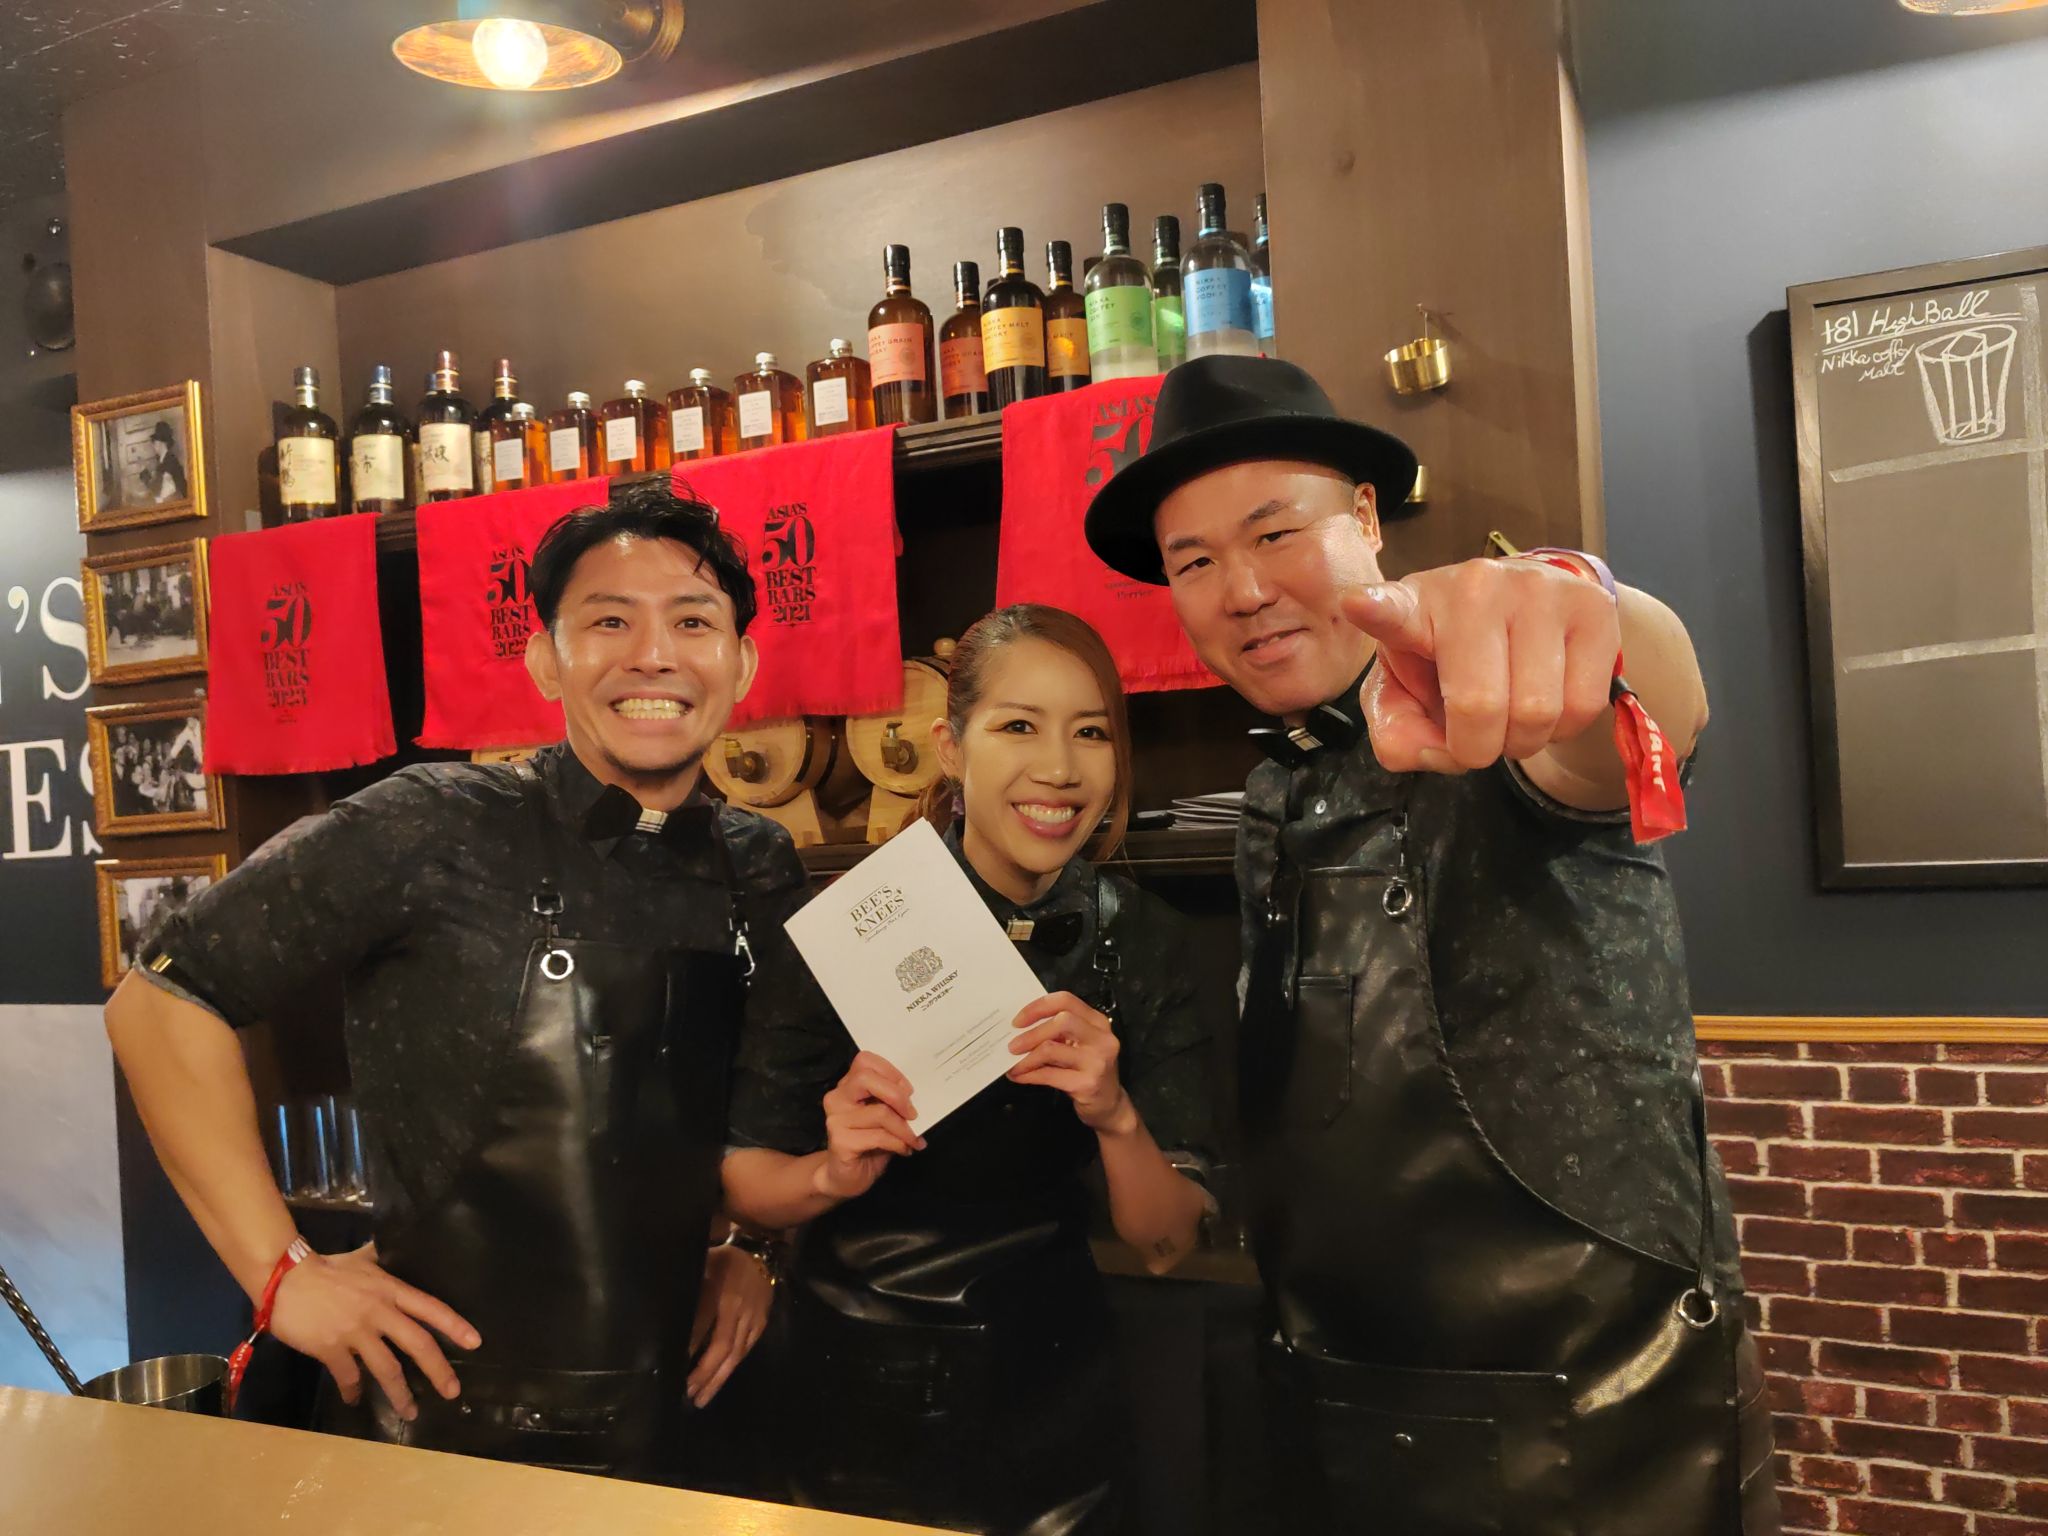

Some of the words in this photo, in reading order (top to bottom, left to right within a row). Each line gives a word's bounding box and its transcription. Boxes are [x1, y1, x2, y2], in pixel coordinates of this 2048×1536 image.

[765, 502, 808, 521] ASIA'S
[761, 515, 815, 569] 50
[486, 558, 532, 608] 50
[765, 566, 817, 588] BEST
[767, 585, 817, 606] BARS
[260, 596, 312, 650] 50
[491, 604, 533, 625] BEST
[772, 604, 813, 623] 2021
[492, 622, 531, 641] BARS
[264, 649, 310, 671] BEST
[265, 671, 310, 688] BARS
[850, 886, 893, 922] BEE'S
[854, 895, 905, 937] KNEES
[930, 969, 958, 993] WHISKY
[906, 992, 932, 1013] NIKKA
